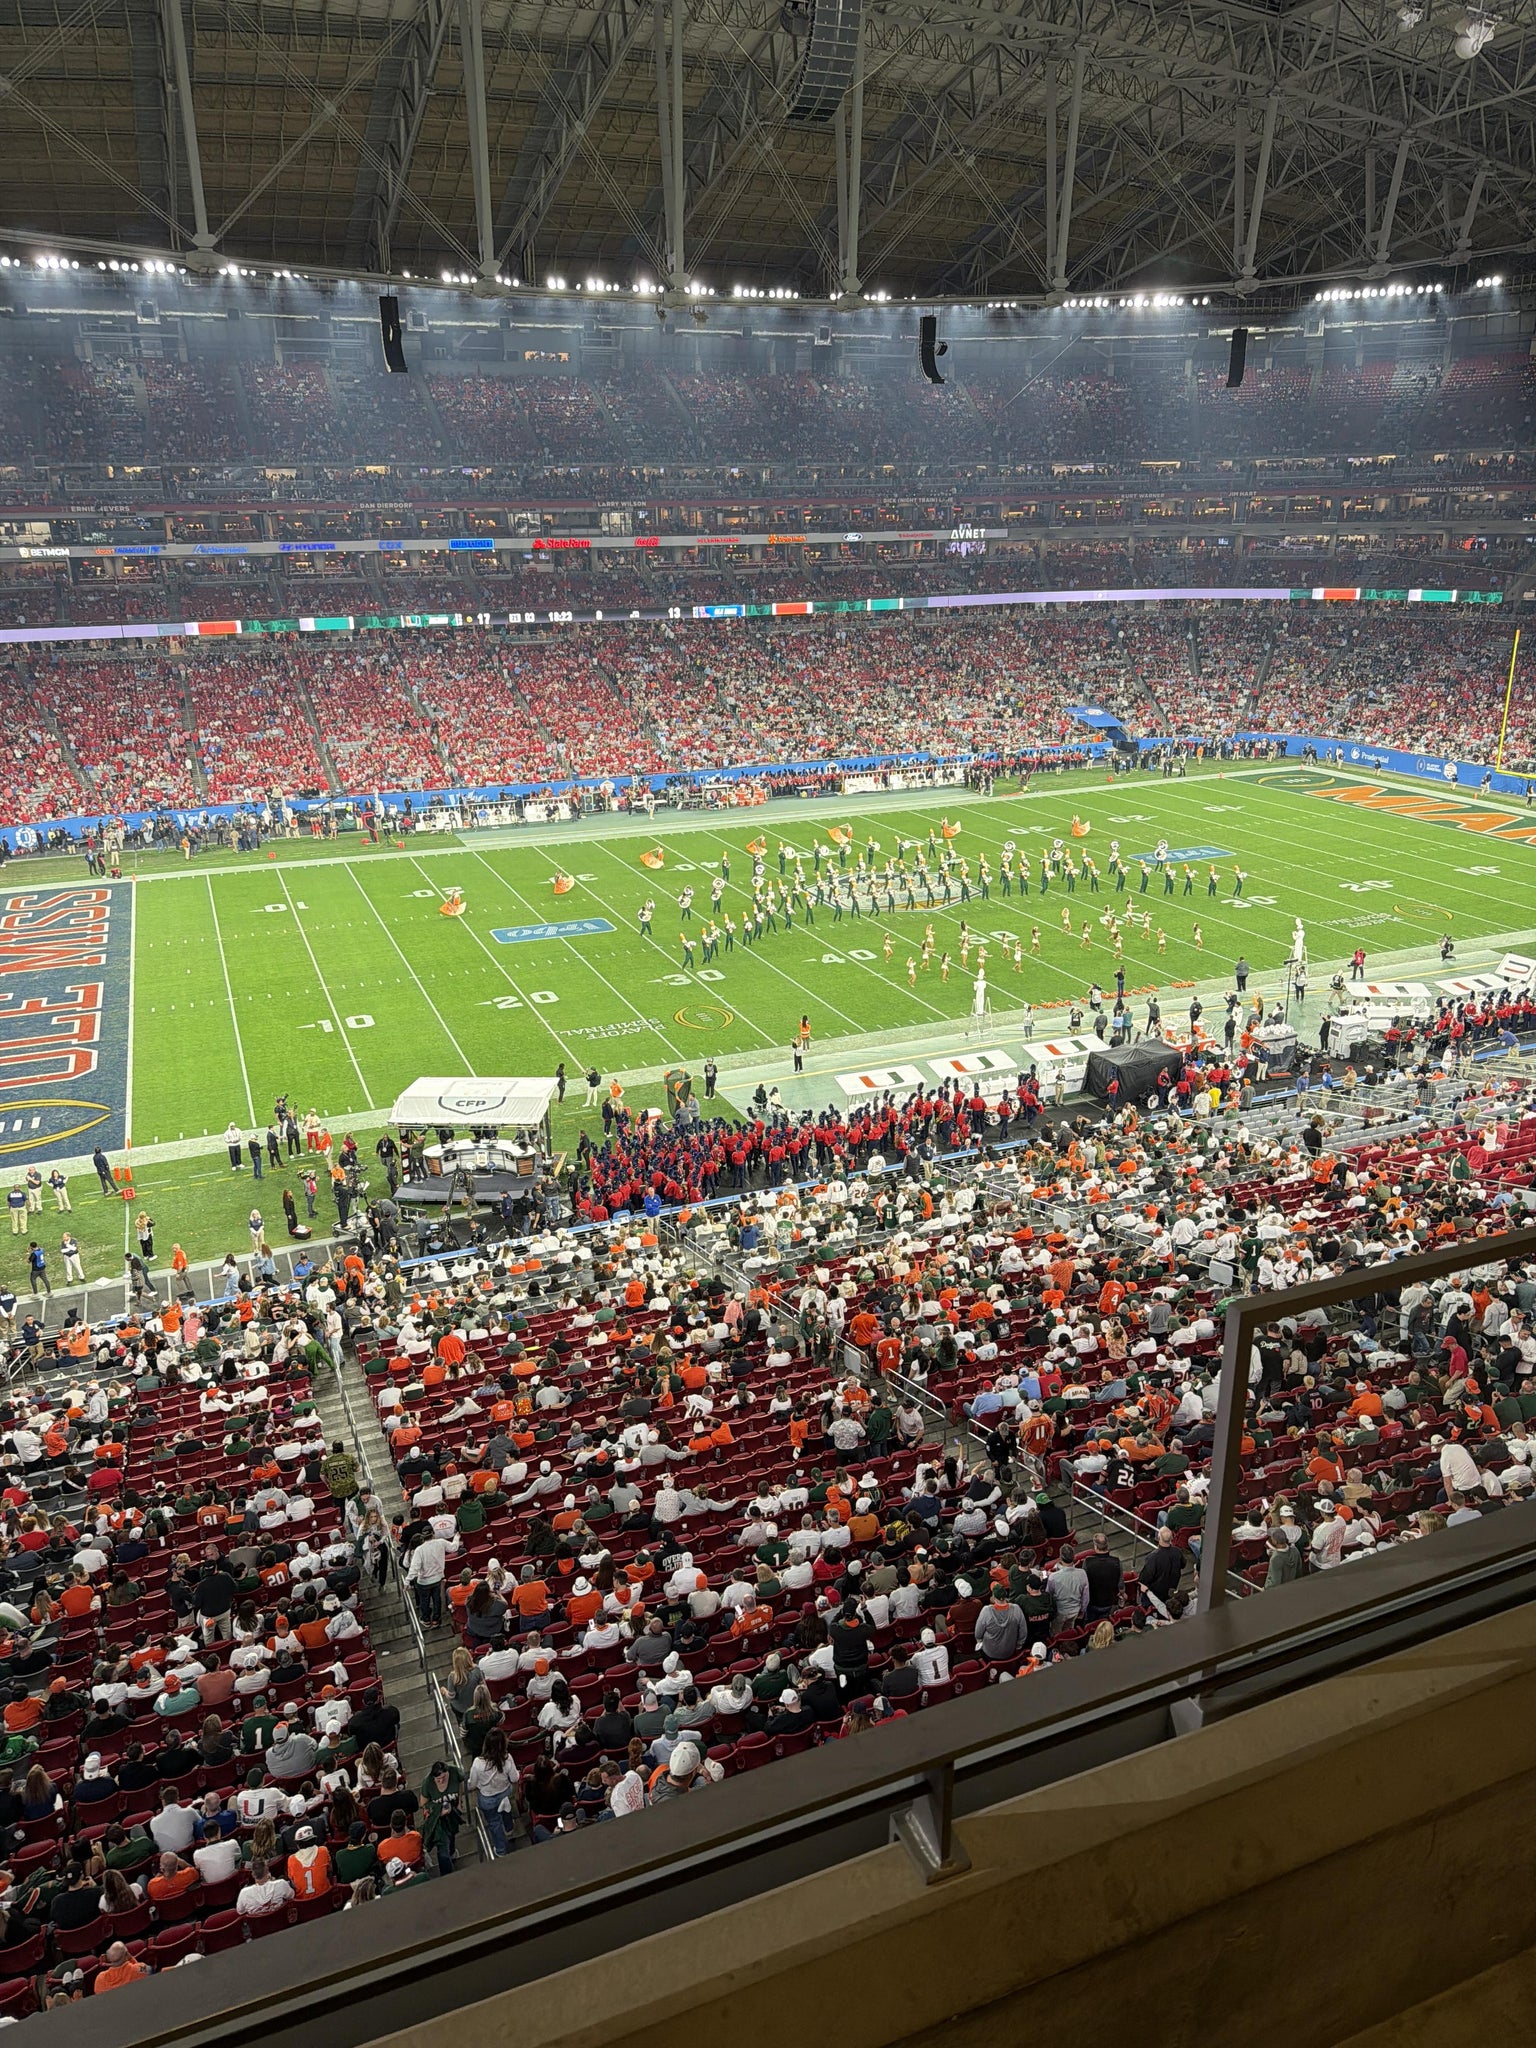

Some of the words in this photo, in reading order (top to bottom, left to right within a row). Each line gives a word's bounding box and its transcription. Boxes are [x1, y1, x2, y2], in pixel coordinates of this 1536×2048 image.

[477, 613, 490, 624] 17
[668, 607, 680, 618] 13
[821, 949, 878, 965] 40
[662, 969, 726, 986] 30
[493, 991, 560, 1009] 20
[317, 1014, 376, 1033] 10
[455, 1099, 487, 1107] CFP
[854, 1189, 866, 1199] 26
[1251, 1245, 1257, 1257] 1
[1111, 1294, 1119, 1306] 4
[888, 1347, 895, 1359] 1
[1310, 1398, 1323, 1409] 10
[634, 1434, 643, 1446] 4
[1035, 1426, 1045, 1440] 11
[331, 1465, 348, 1481] 25
[1117, 1469, 1134, 1487] 26
[1335, 1466, 1343, 1482] 1
[203, 1513, 218, 1525] 81
[772, 1554, 780, 1566] 1
[266, 1570, 286, 1587] 20
[932, 1660, 941, 1680] 1
[254, 1727, 263, 1750] 1
[243, 1799, 265, 1817] U
[304, 1870, 315, 1895] 1
